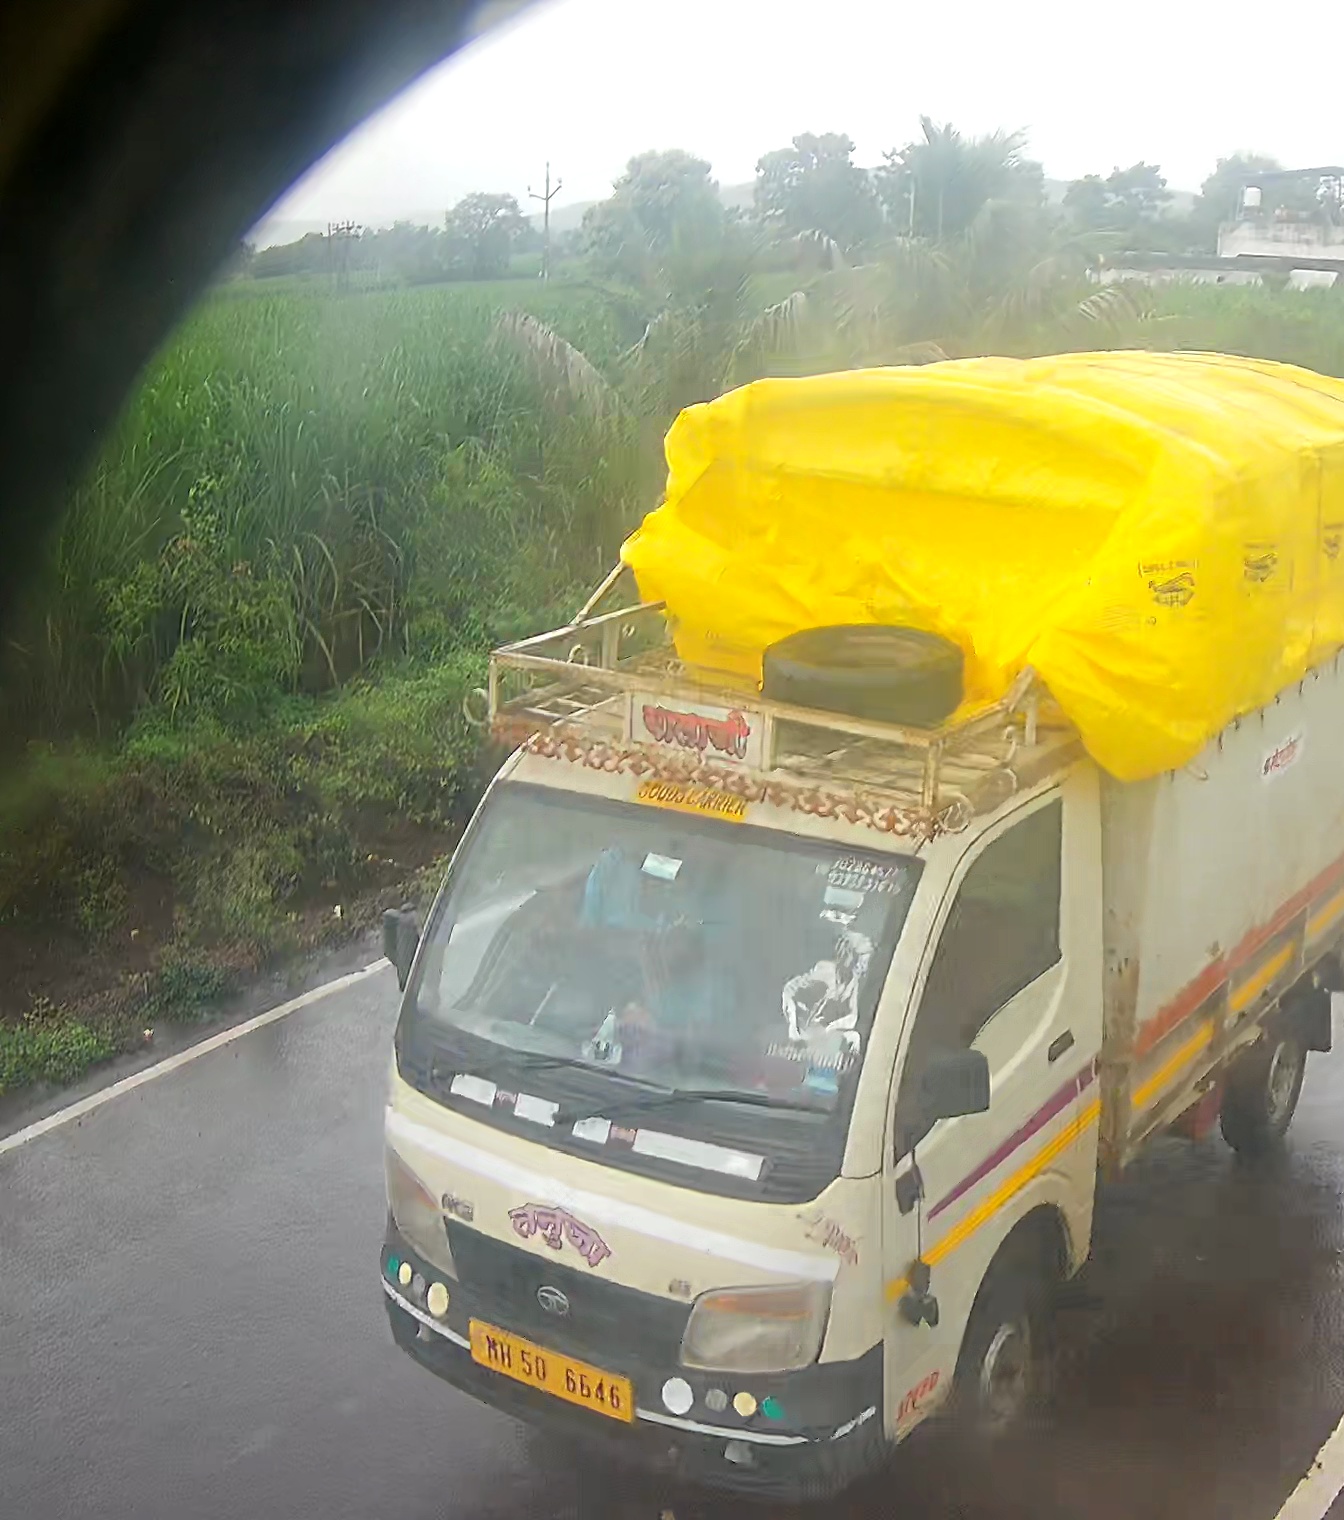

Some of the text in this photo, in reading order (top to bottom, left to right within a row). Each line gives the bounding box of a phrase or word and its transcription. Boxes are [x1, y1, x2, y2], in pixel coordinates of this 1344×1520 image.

[485, 1334, 621, 1410] MH 50 6646
